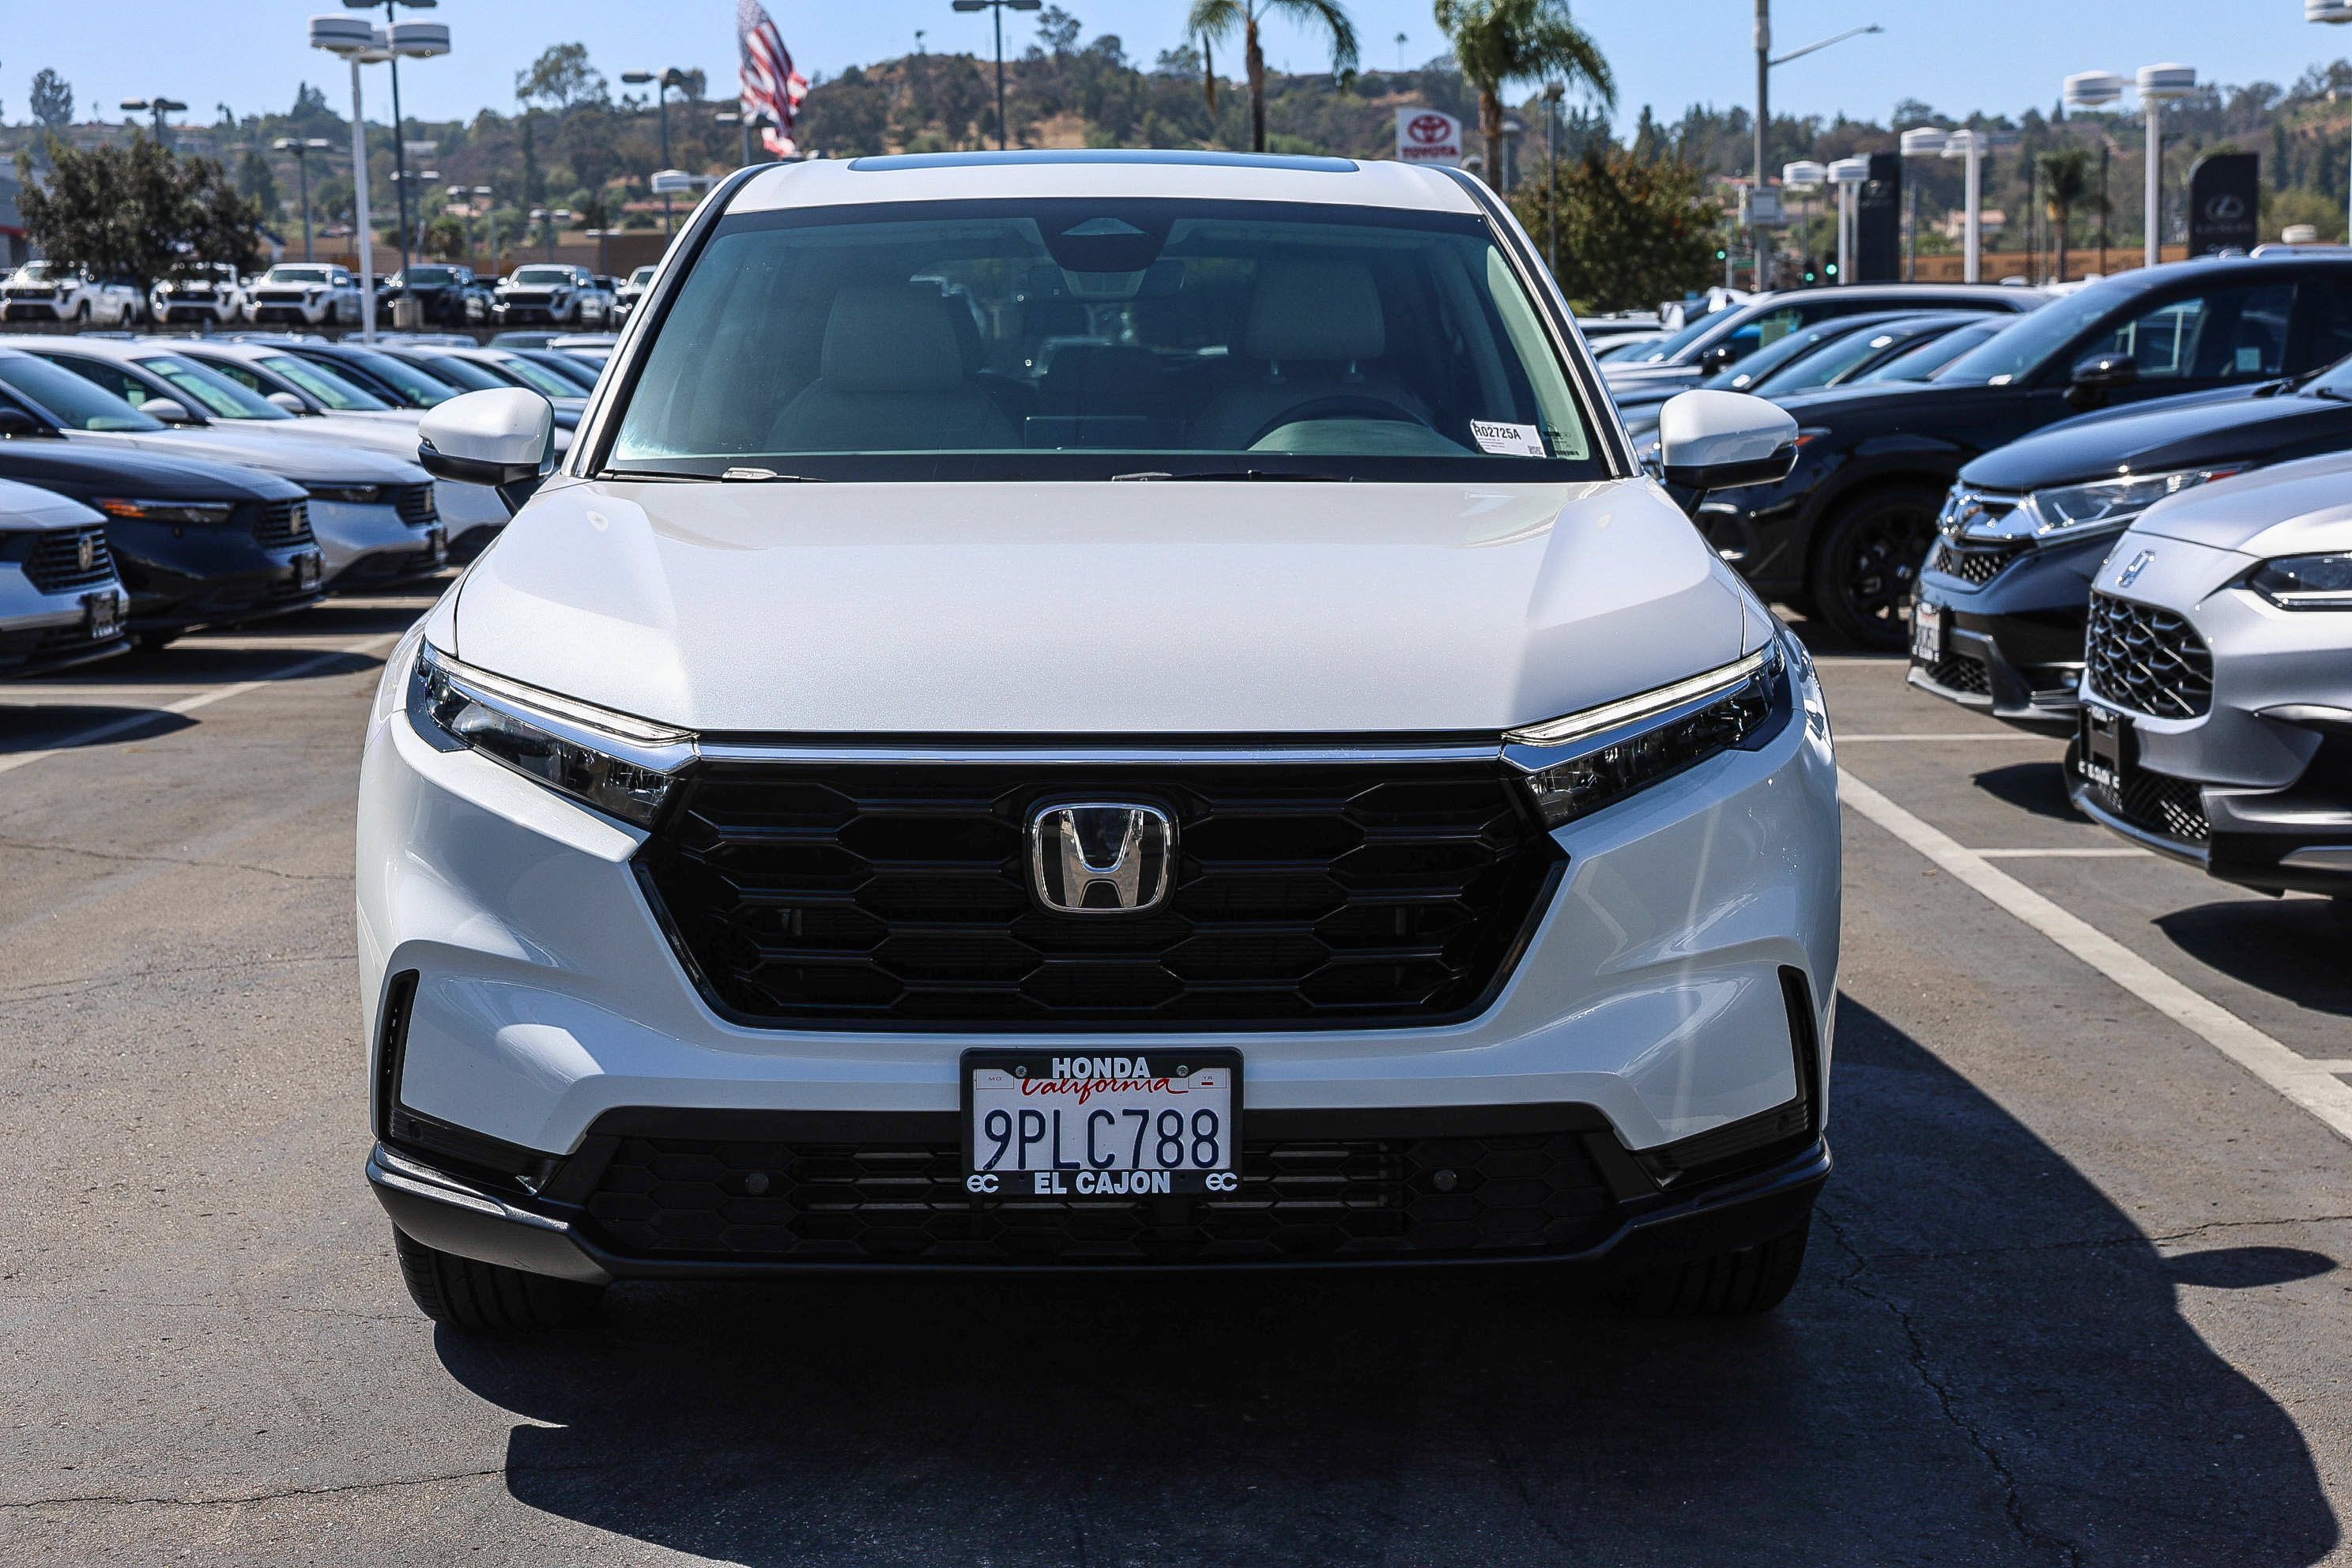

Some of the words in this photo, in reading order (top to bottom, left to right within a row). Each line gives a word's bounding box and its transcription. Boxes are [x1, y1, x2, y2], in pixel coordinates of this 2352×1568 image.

[1474, 425, 1521, 439] R02725A
[1053, 1057, 1151, 1079] HONDA
[1021, 1077, 1189, 1104] California
[982, 1109, 1219, 1170] 9PLC788
[1035, 1173, 1067, 1194] EL
[1076, 1172, 1170, 1193] CAJON
